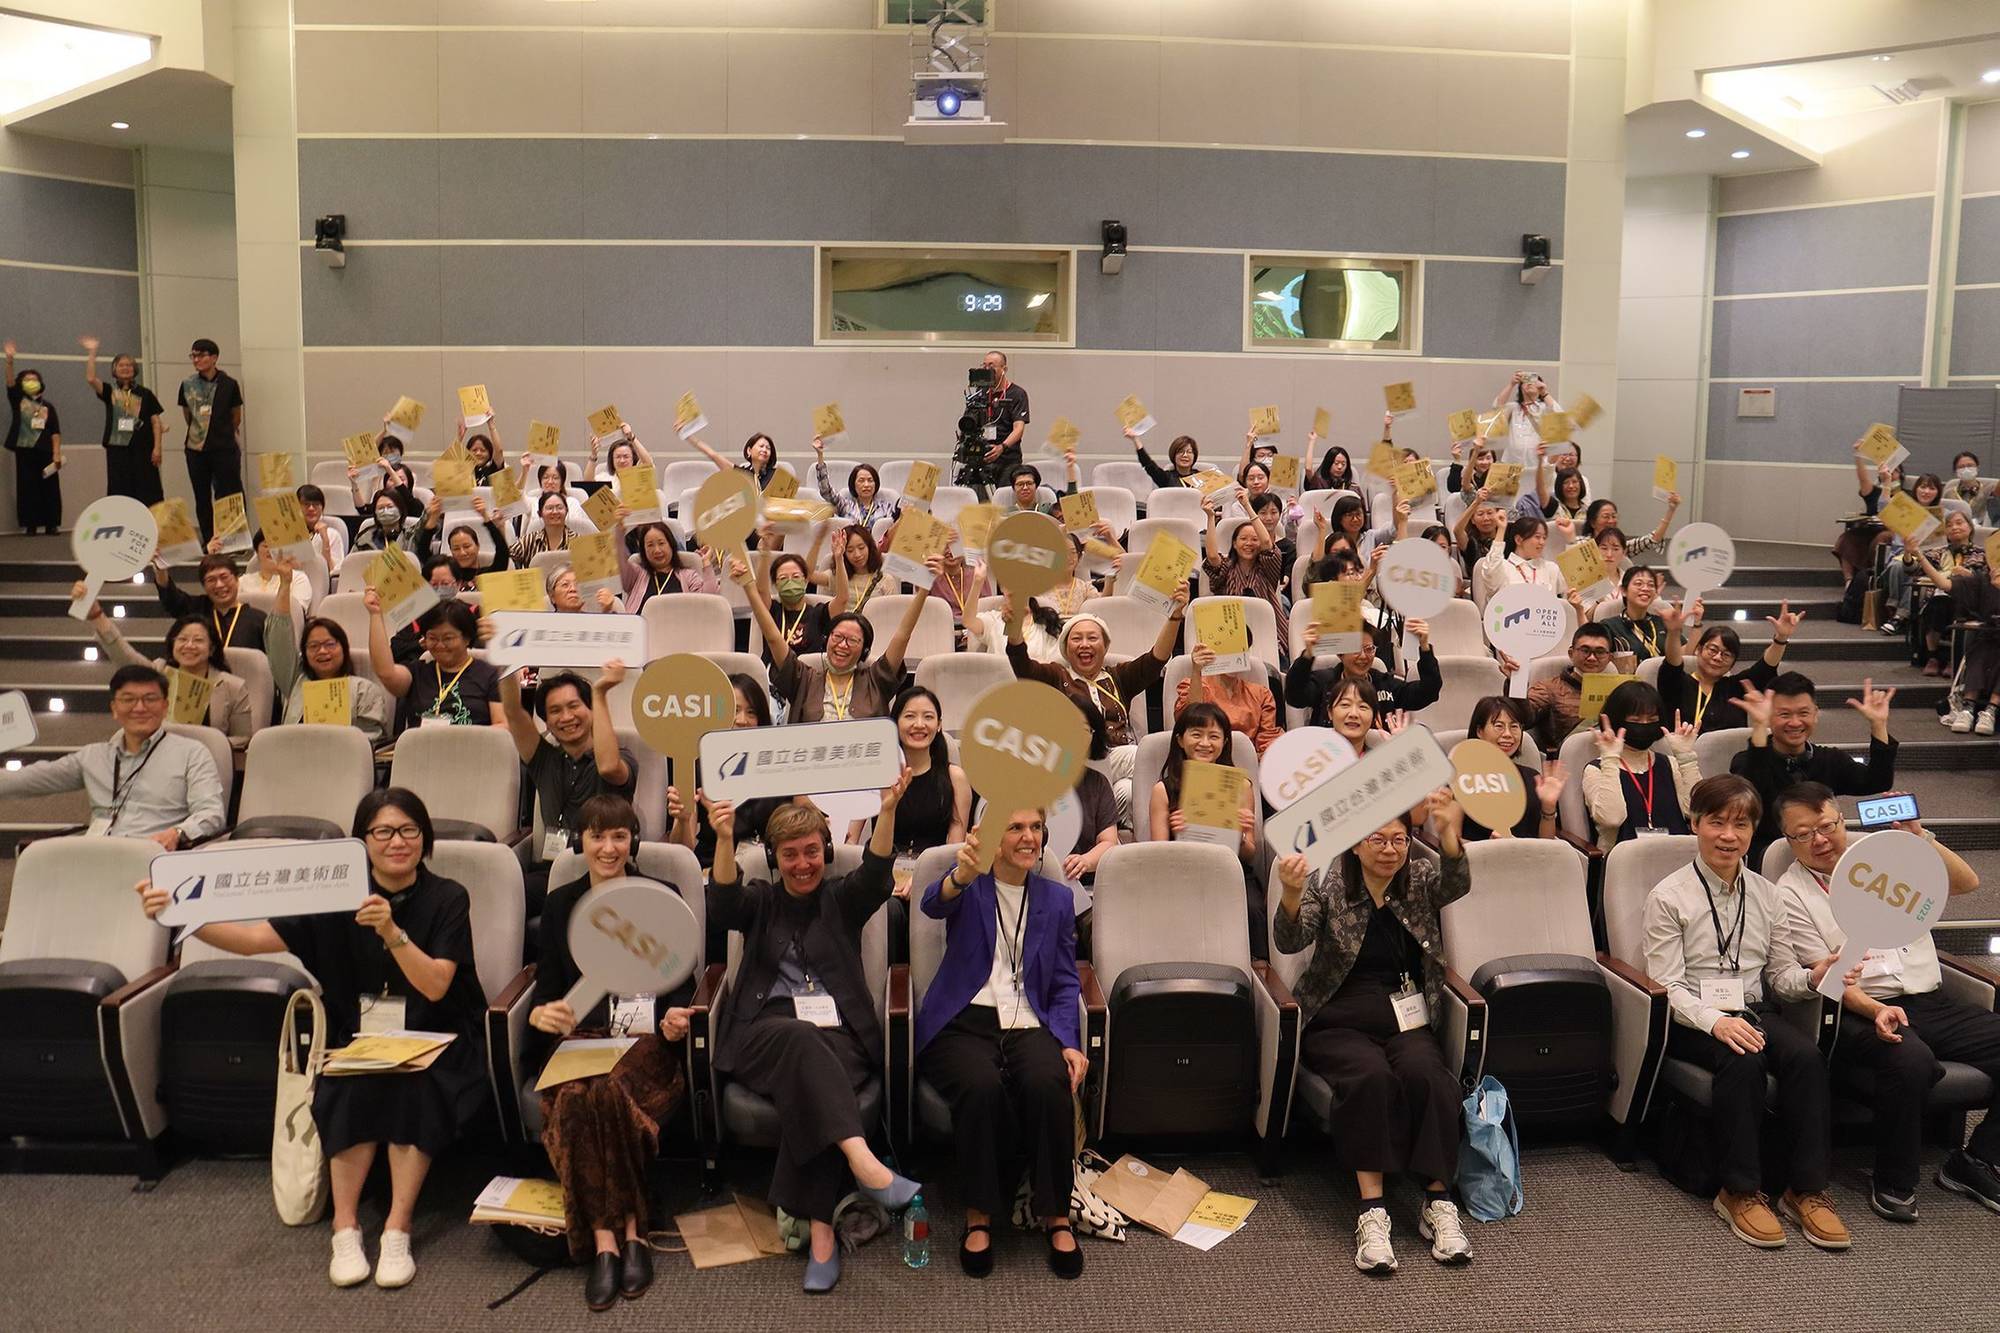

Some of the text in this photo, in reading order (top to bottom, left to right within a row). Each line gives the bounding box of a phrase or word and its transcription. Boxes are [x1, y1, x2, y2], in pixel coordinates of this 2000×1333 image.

[965, 294, 1002, 312] 9:29
[642, 694, 711, 718] CASI
[757, 742, 882, 766] 國立台灣美術館
[973, 718, 1062, 773] CASI
[1278, 749, 1335, 801] CASI
[1458, 772, 1510, 795] CASI
[1864, 803, 1904, 819] CASI
[214, 864, 350, 890] 國立台灣美術館
[1848, 862, 1922, 914] CASI
[1916, 897, 1935, 922] 2025
